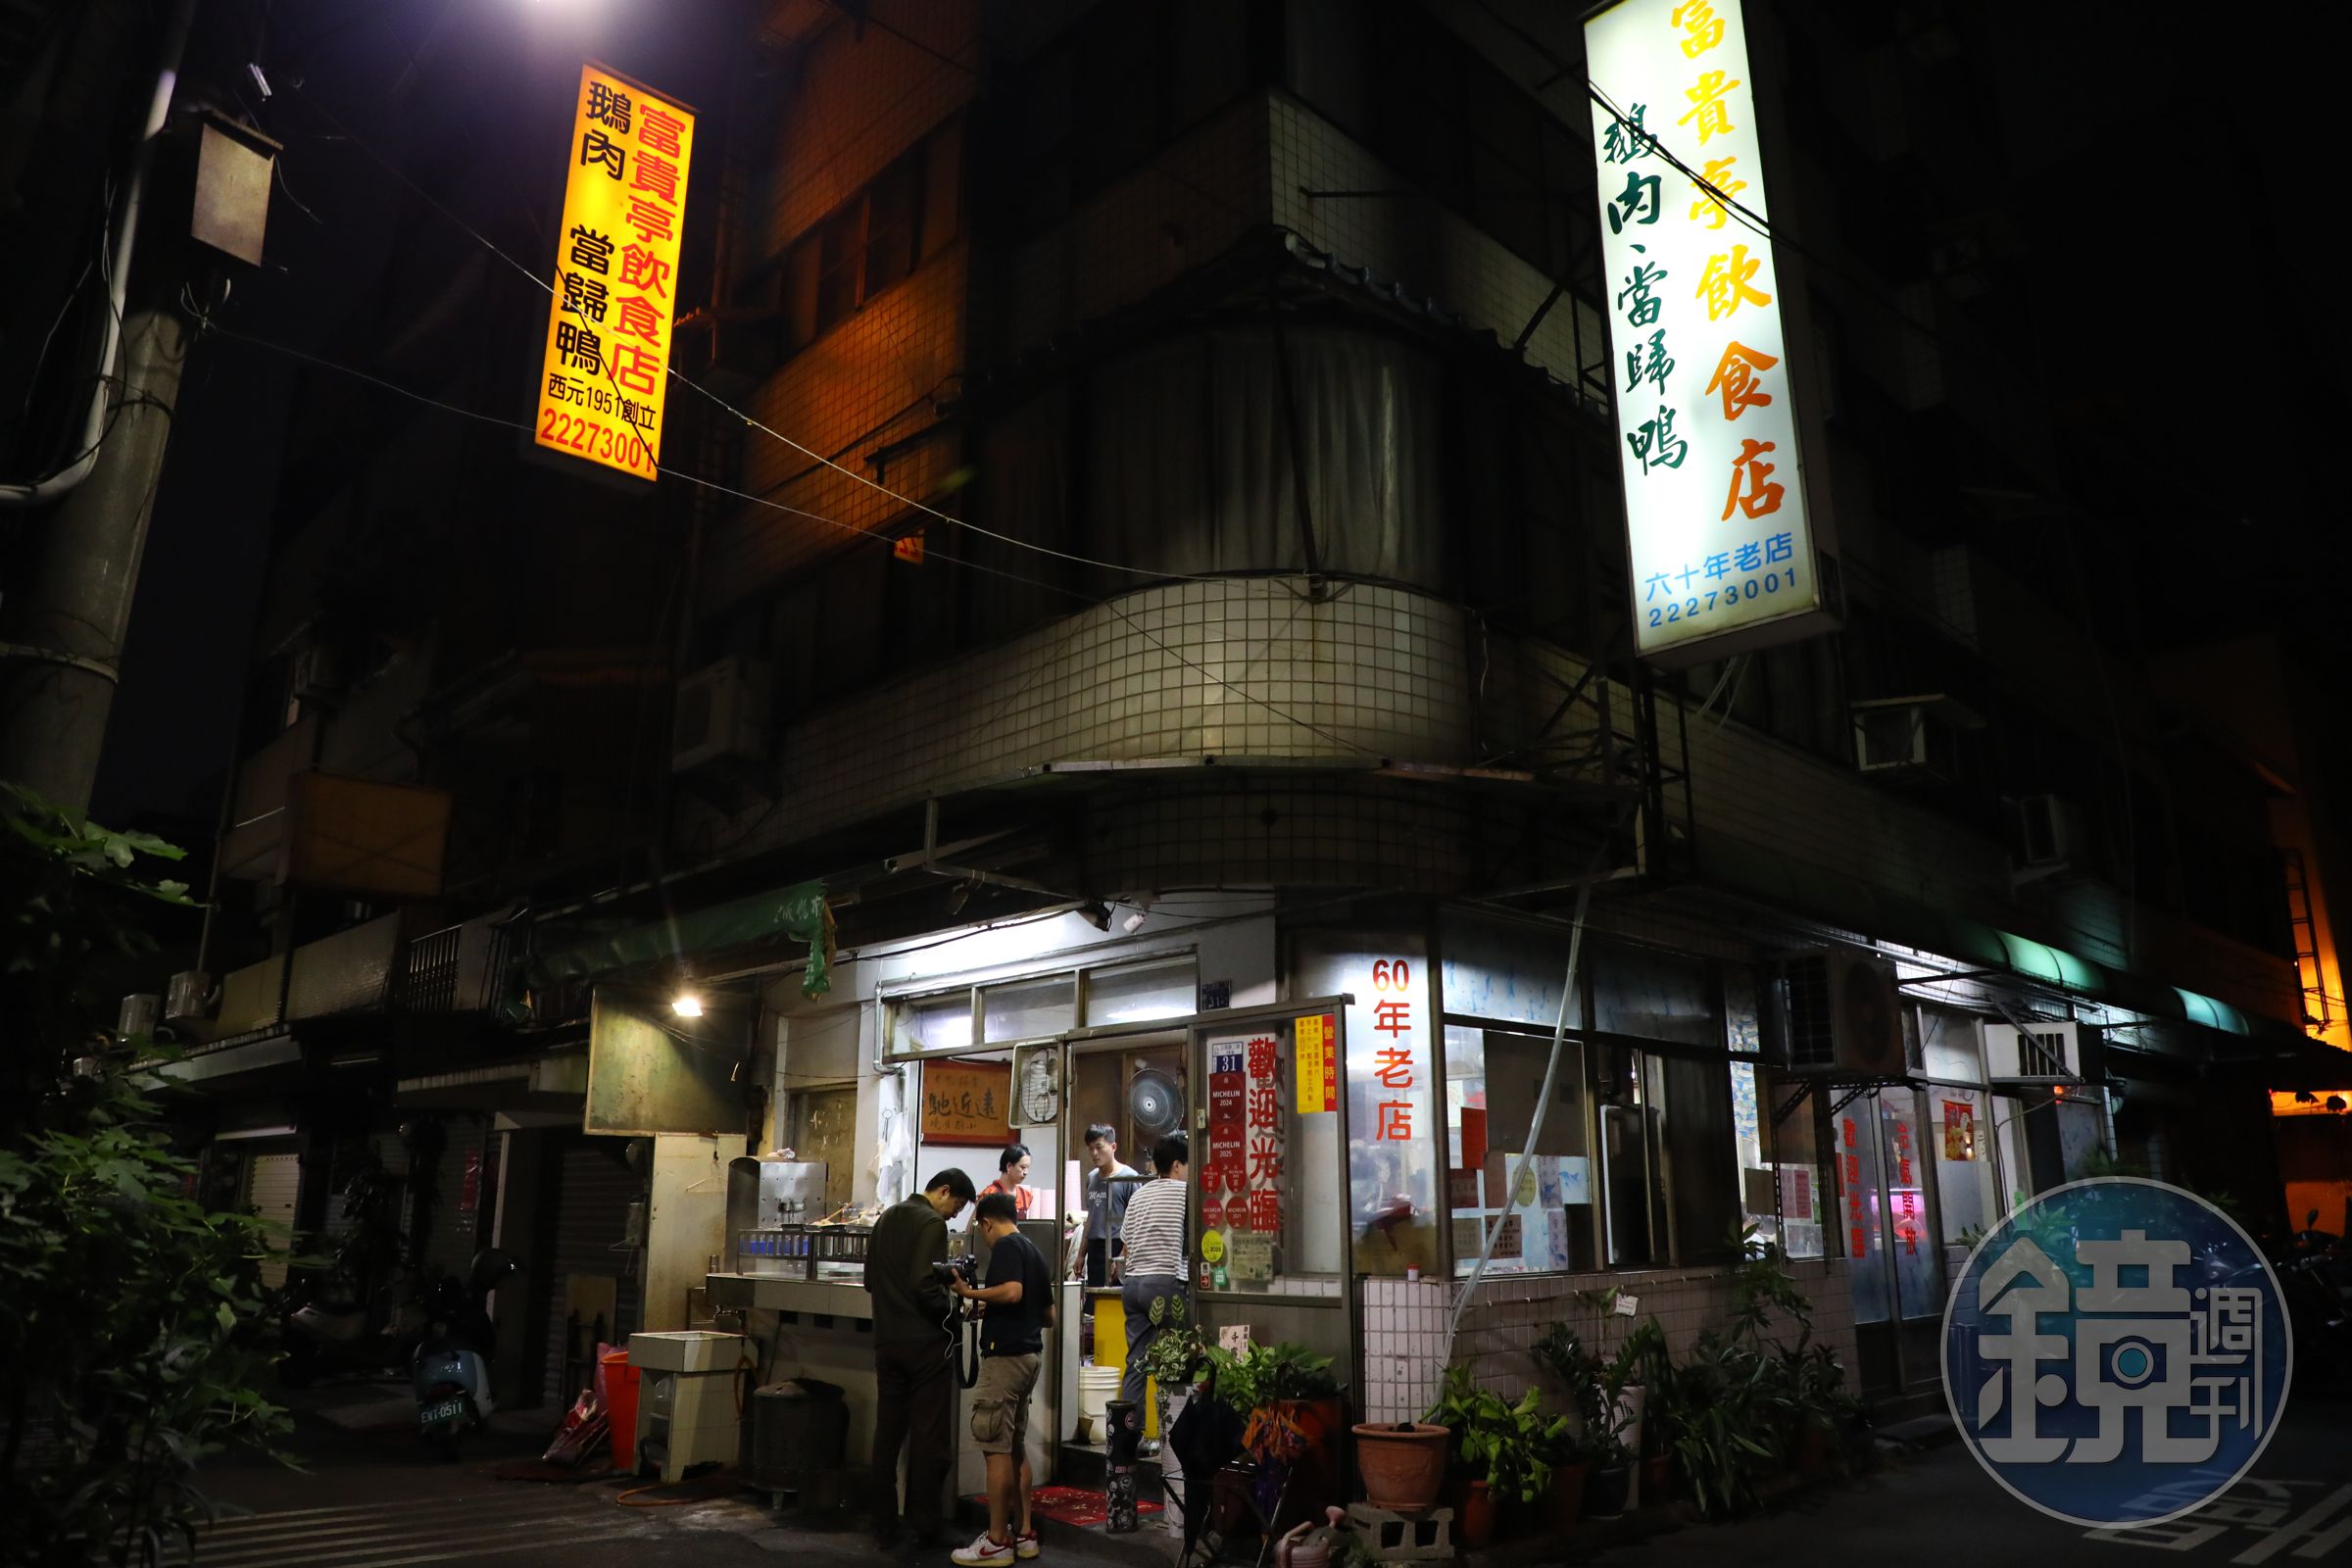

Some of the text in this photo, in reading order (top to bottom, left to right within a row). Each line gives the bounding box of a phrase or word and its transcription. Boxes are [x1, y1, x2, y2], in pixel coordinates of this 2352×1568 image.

[555, 80, 632, 376] 鵝肉 當歸鴨
[607, 103, 686, 395] 富貴亭飲食店
[1671, 0, 1786, 521] 富貴亭飲食店
[548, 372, 658, 430] 西元1951創立
[540, 408, 655, 472] 22273001
[1644, 532, 1793, 602] 六十年老店
[1649, 567, 1796, 628] 22273001
[1222, 1055, 1237, 1071] 31
[1323, 1027, 1336, 1100] 營業時間
[1373, 959, 1413, 1141] 60年老店
[1248, 1037, 1279, 1232] 歡迎光臨
